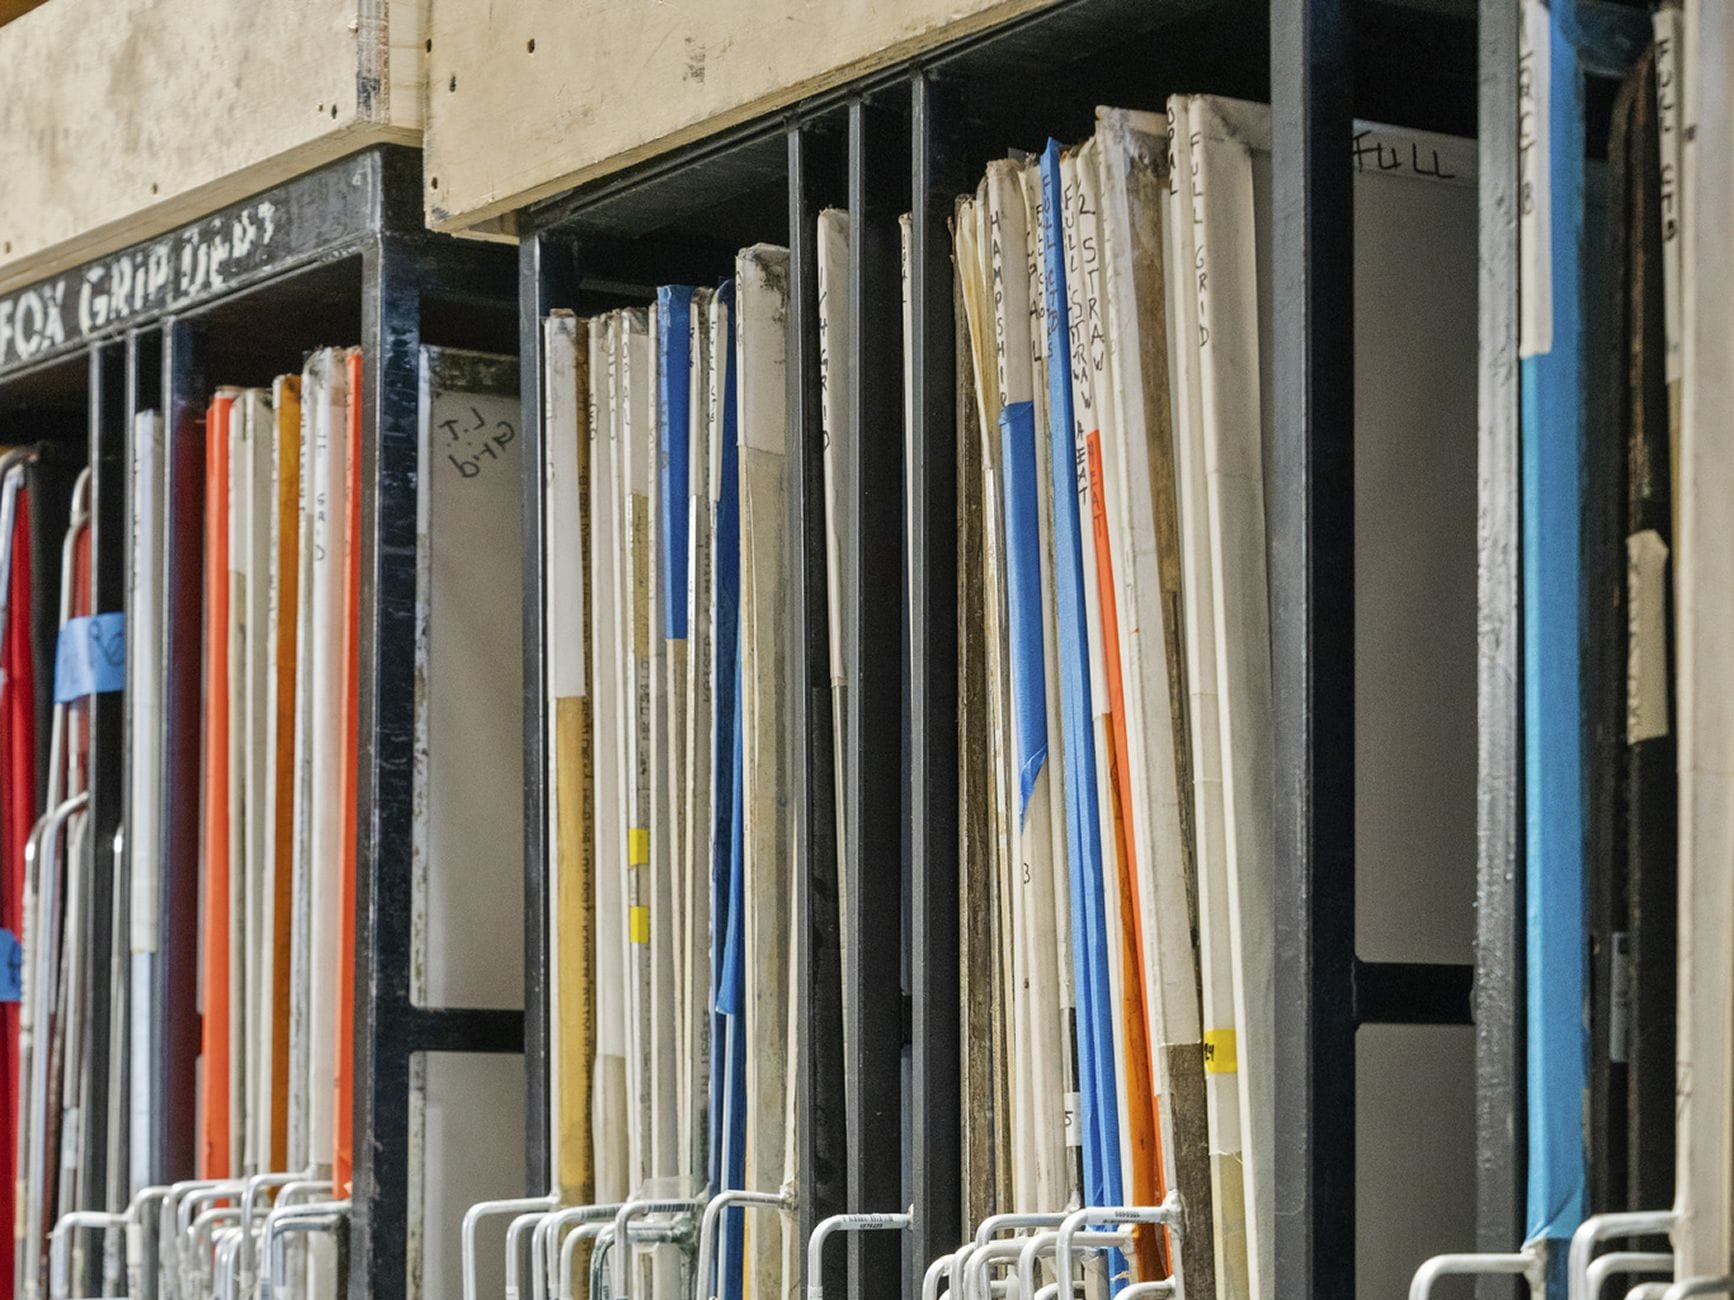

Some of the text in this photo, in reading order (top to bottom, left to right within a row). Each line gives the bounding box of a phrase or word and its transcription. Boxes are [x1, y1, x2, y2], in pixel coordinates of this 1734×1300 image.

[1167, 106, 1179, 196] OPAL
[1064, 184, 1078, 273] FULL
[1190, 135, 1210, 347] FULL GRID
[990, 210, 1008, 407] HAMPSHIR
[1083, 237, 1105, 372] STRAW
